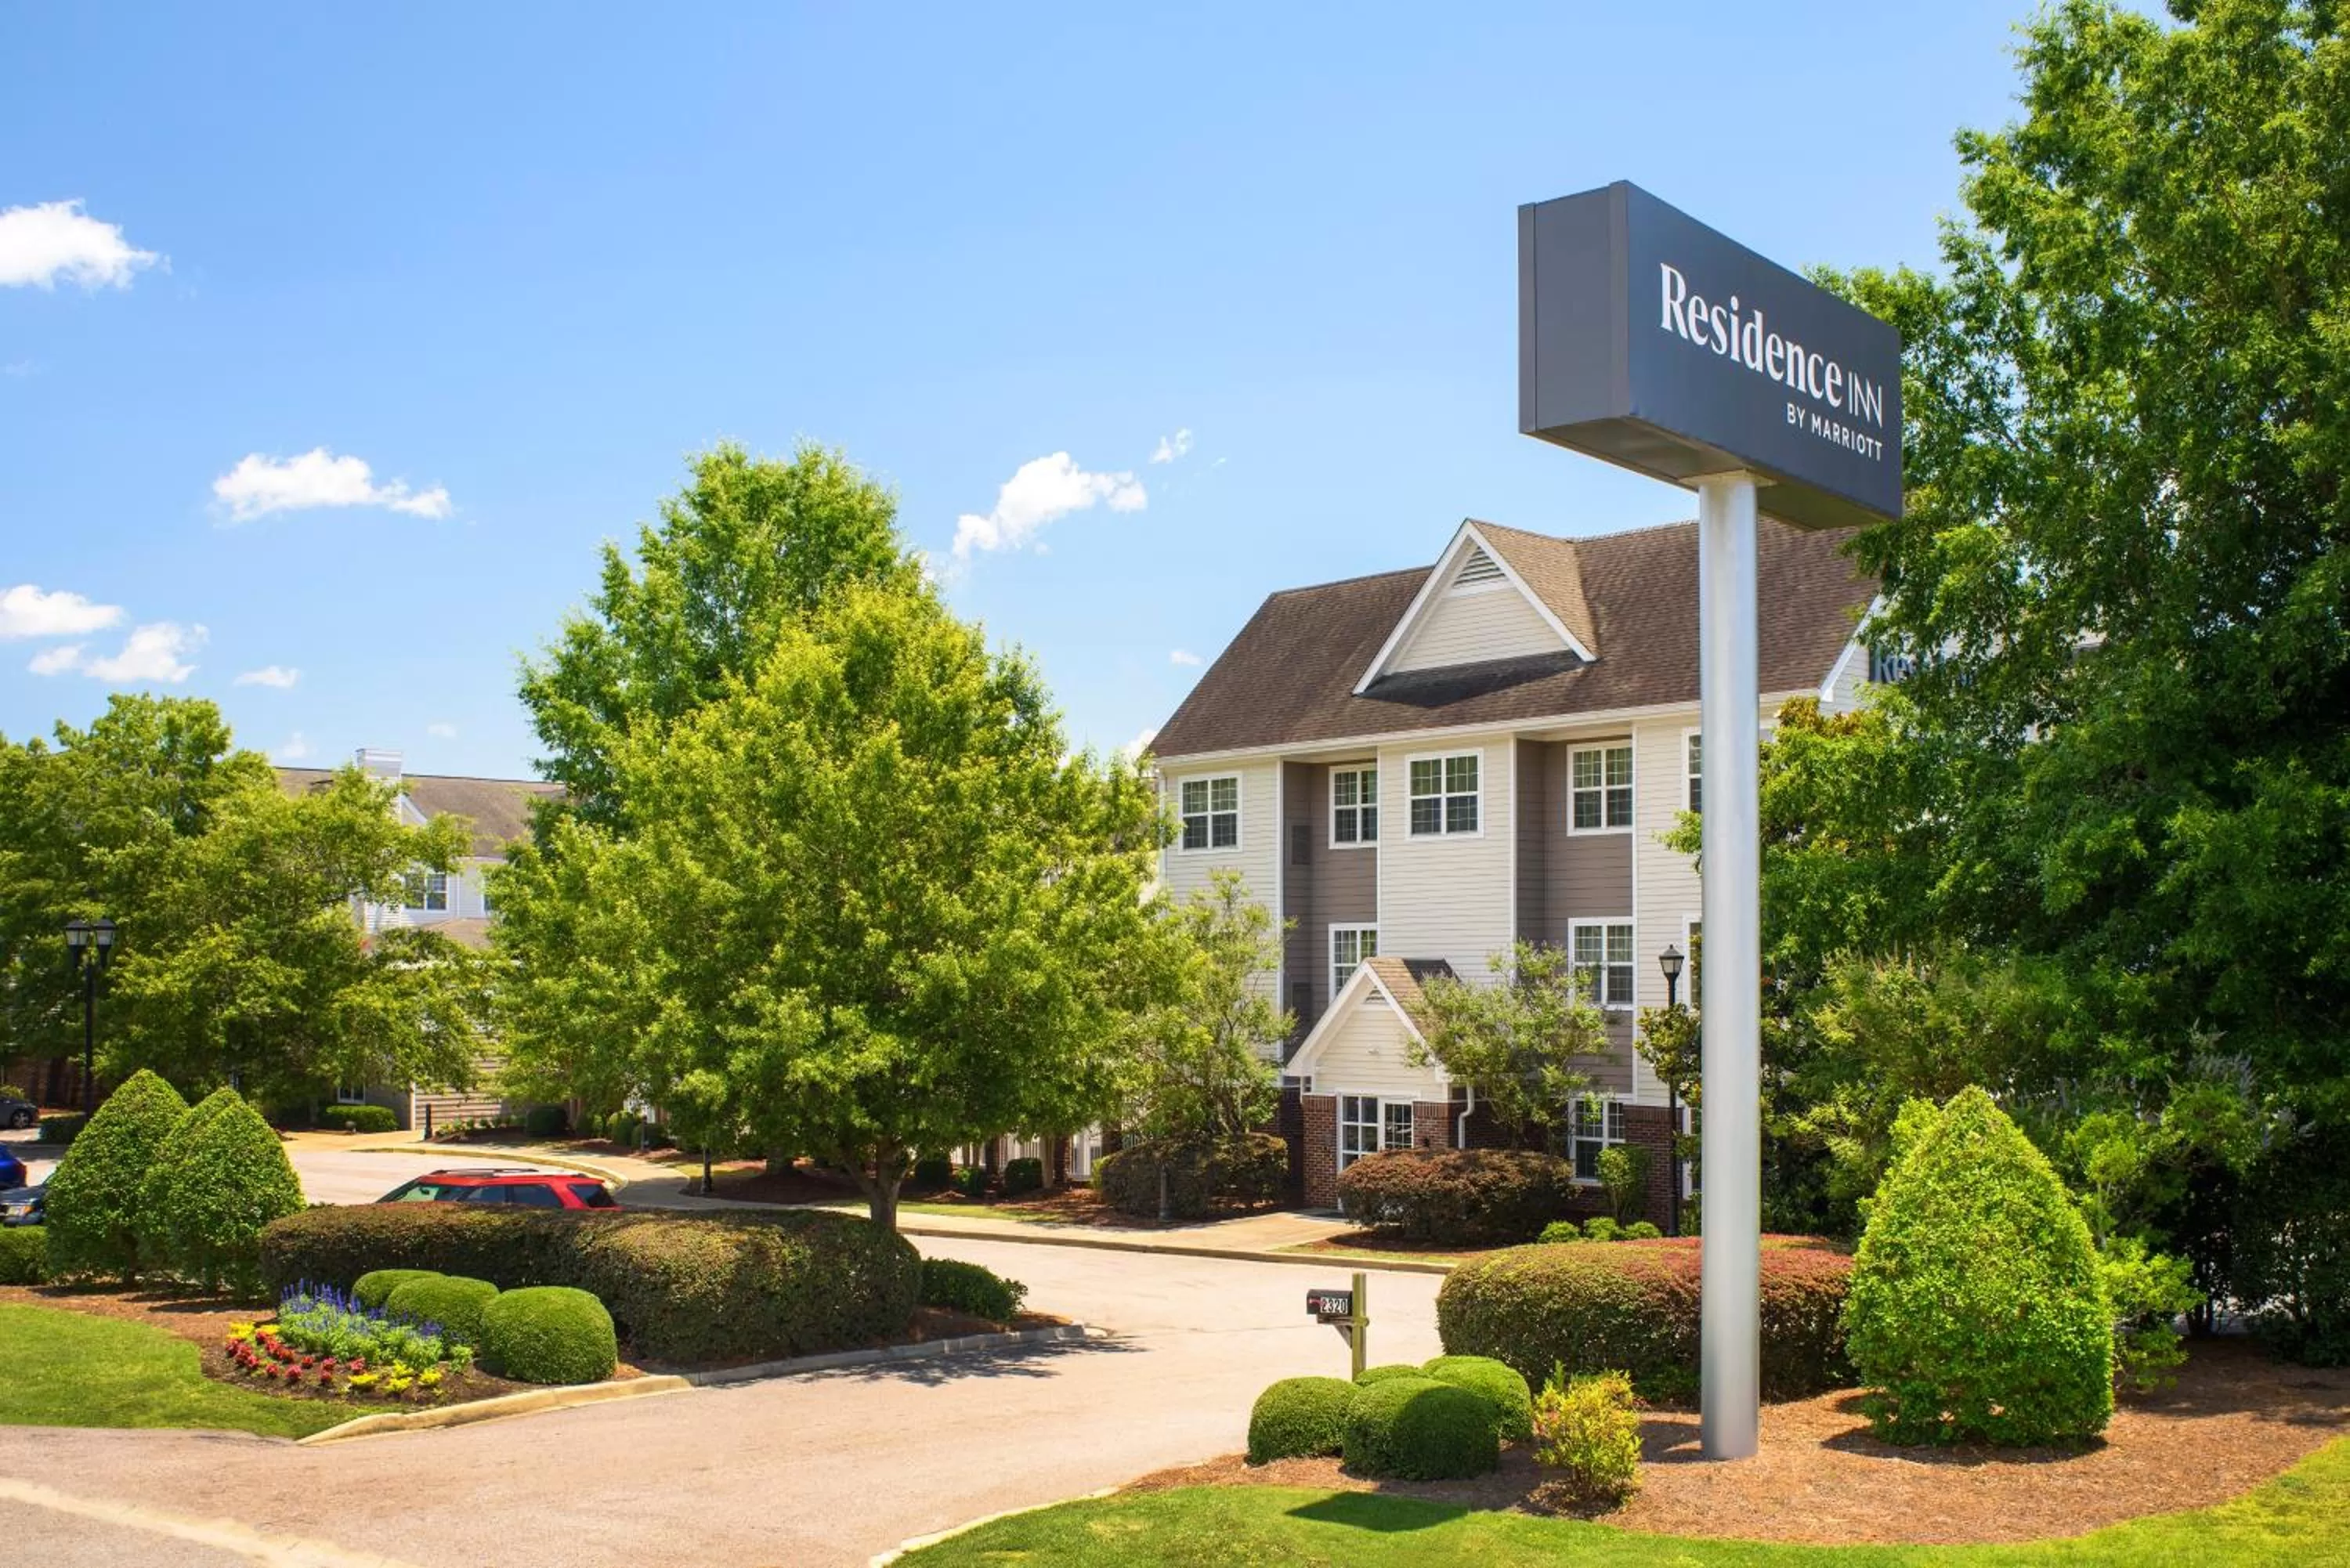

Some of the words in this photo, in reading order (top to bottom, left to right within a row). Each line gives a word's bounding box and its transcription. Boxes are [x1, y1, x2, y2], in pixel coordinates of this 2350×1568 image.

[1660, 262, 1842, 407] Residence
[1849, 370, 1882, 428] INN
[1787, 402, 1806, 429] BY
[1811, 413, 1882, 461] MARRIOTT
[1321, 1297, 1347, 1313] 2320
